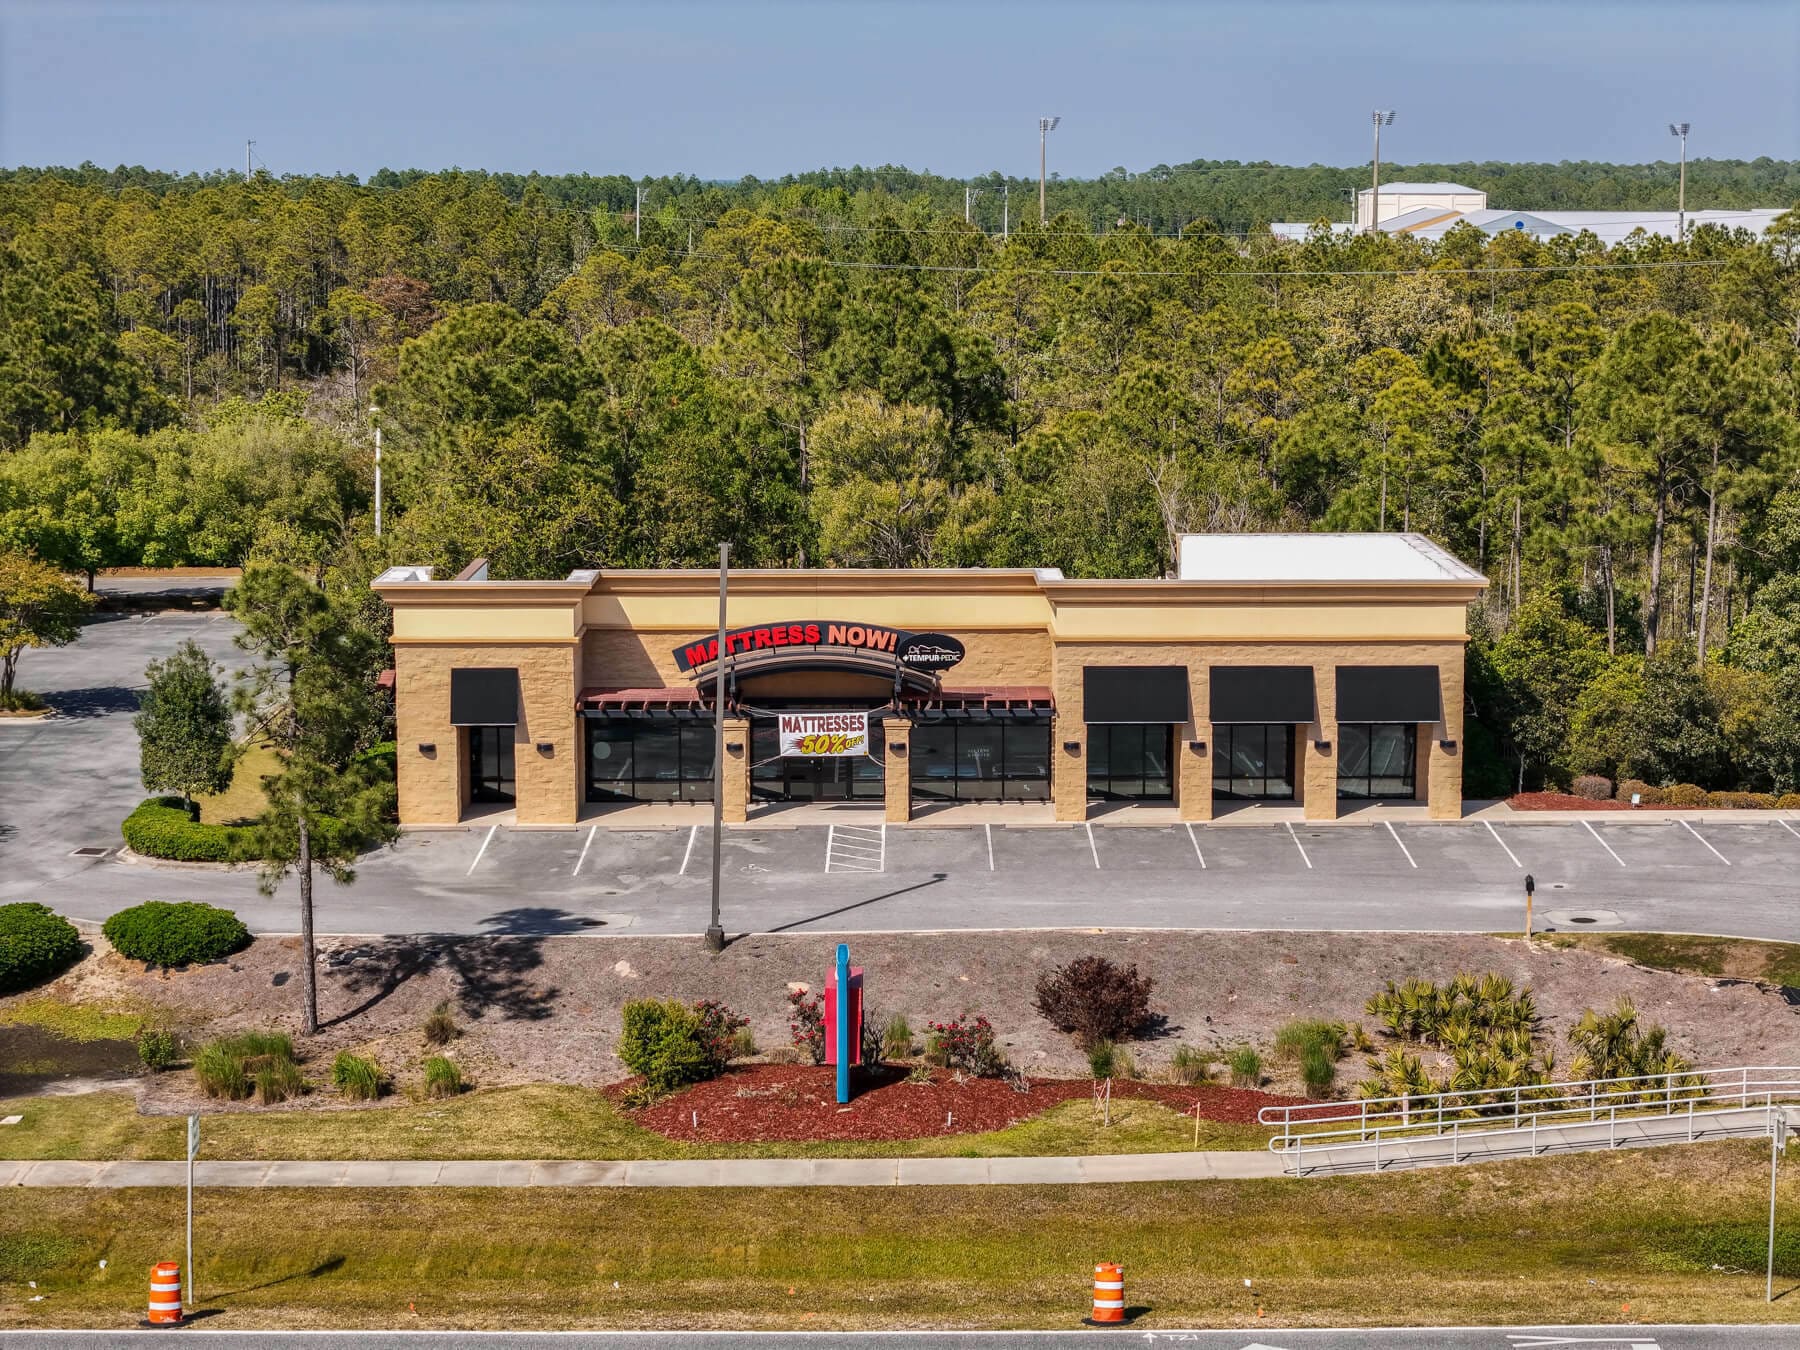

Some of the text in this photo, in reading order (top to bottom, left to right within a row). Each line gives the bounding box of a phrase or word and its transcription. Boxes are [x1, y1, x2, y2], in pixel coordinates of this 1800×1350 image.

[685, 624, 897, 666] MATTRESS NOW!
[782, 715, 865, 733] MATTRESSES
[801, 734, 847, 754] 50%
